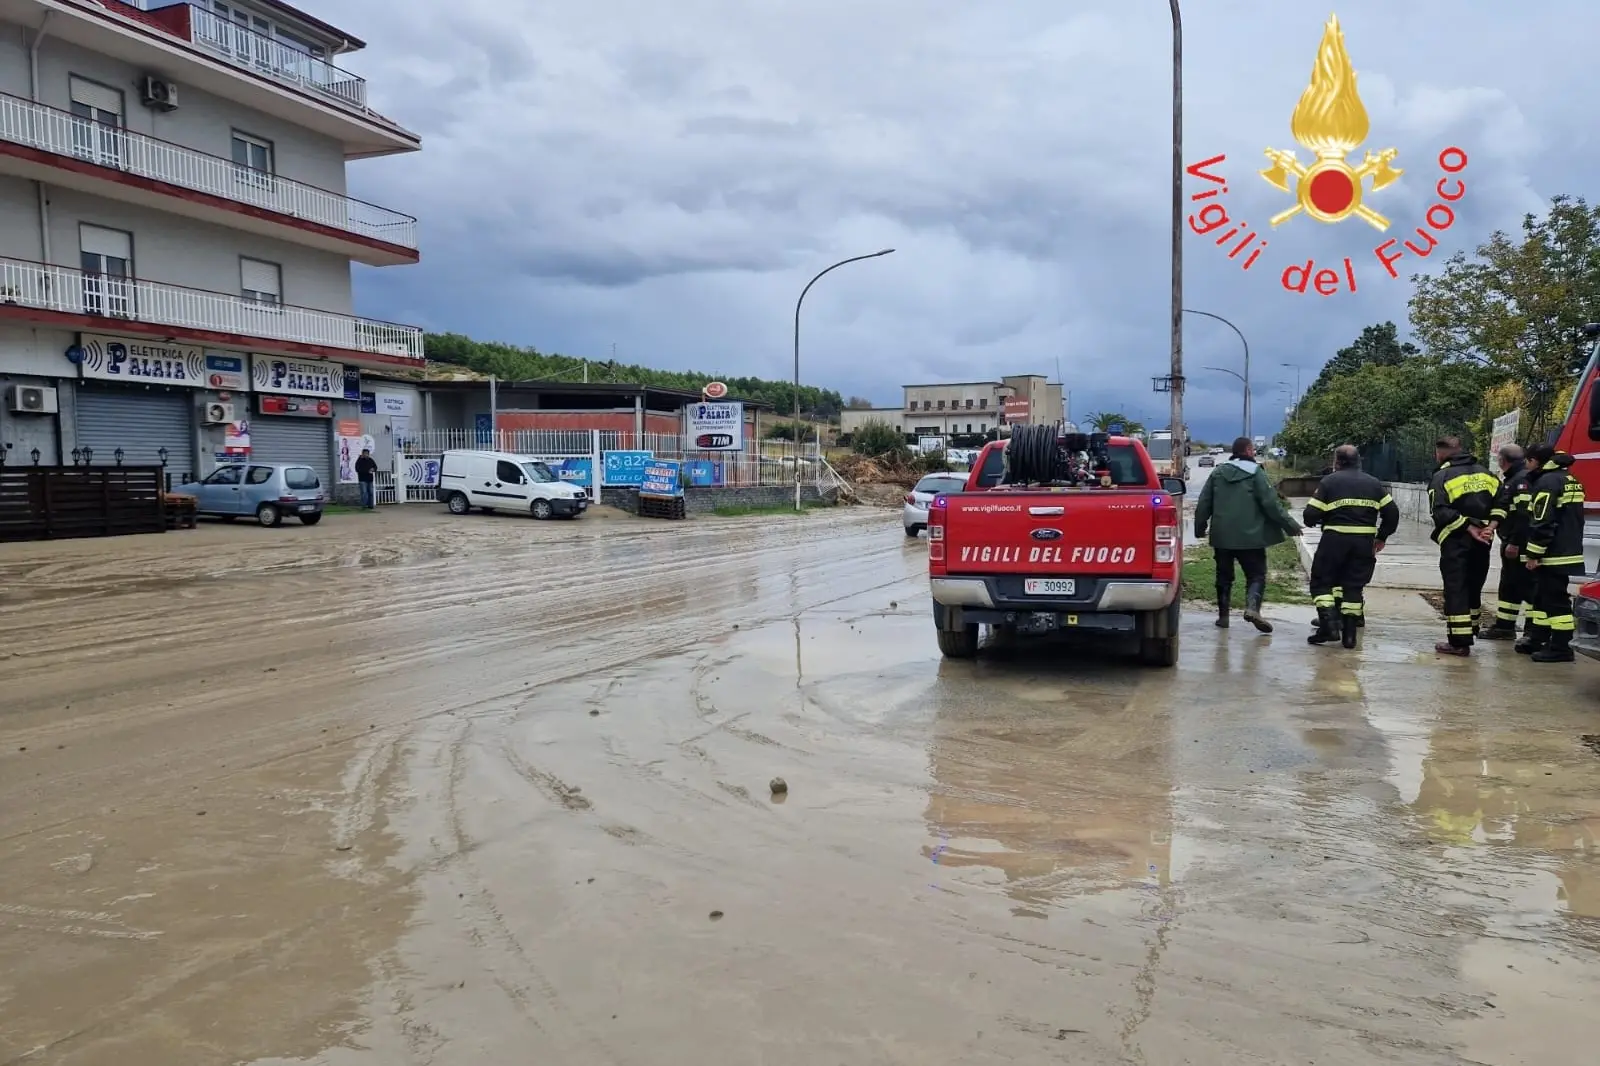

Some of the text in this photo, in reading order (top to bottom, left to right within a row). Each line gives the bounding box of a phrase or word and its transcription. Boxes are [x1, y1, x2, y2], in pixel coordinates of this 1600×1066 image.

[107, 342, 185, 379] PALAIA
[130, 345, 184, 361] ELETTRICA
[271, 360, 330, 392] PALAIA
[289, 362, 328, 375] ELETTRICA
[698, 405, 731, 420] PALAIA
[712, 436, 730, 446] TIM
[961, 546, 1136, 563] VIGILI DEL FUOCO
[1027, 581, 1073, 592] VF 30992
